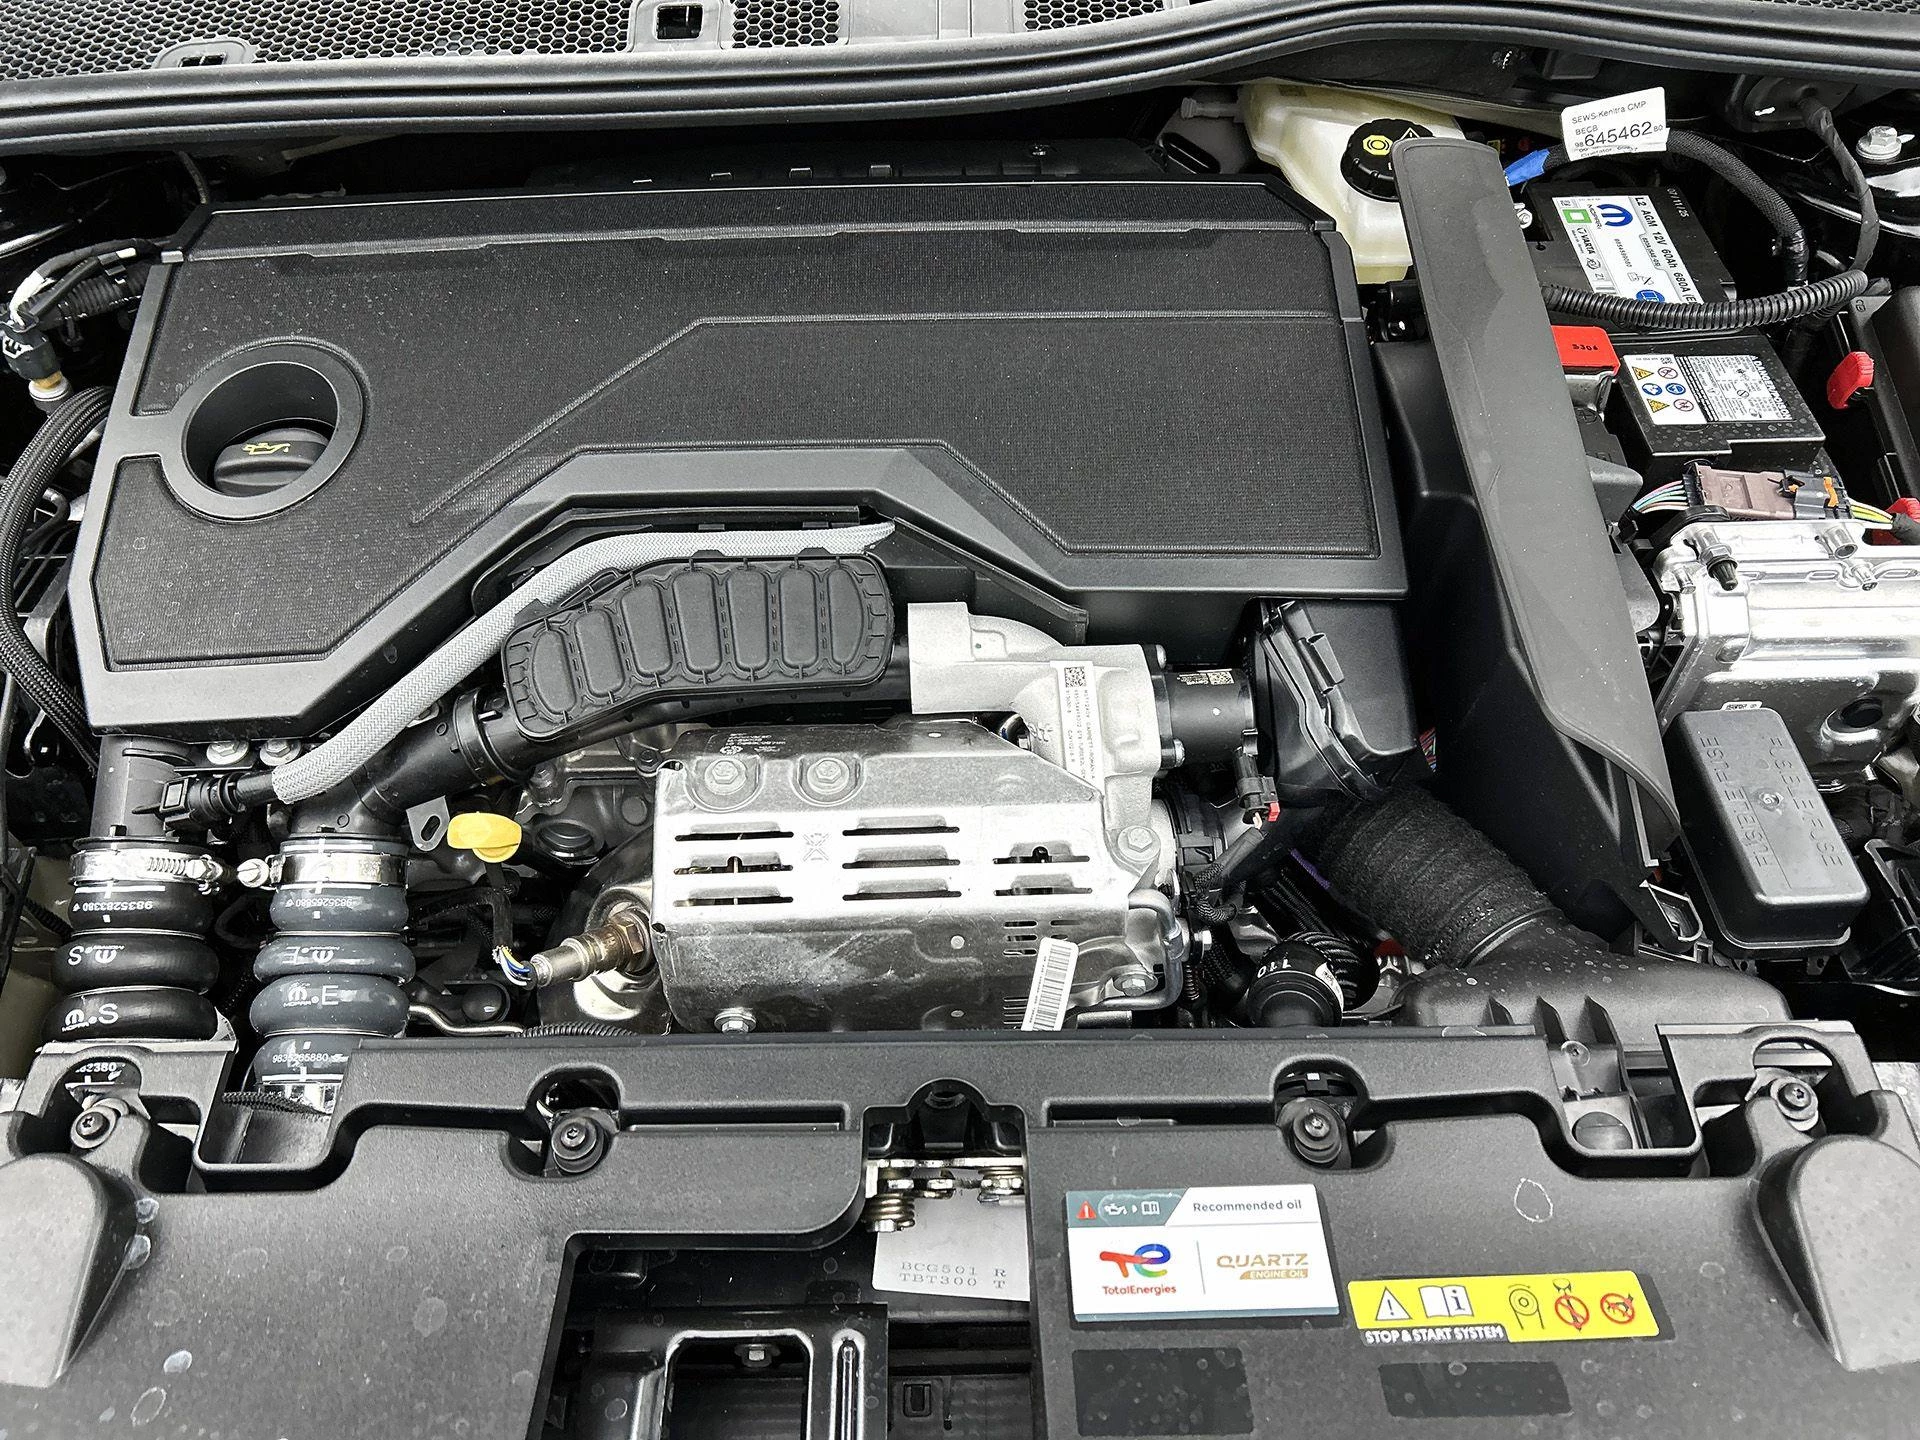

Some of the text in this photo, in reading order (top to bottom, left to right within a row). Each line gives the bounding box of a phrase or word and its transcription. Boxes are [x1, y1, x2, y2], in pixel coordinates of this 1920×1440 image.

[1627, 100, 1647, 111] CMP
[1582, 234, 1596, 255] VARTA
[1641, 210, 1657, 228] AGM
[1652, 231, 1668, 246] 12V
[1662, 248, 1677, 269] 60Ah
[1193, 1200, 1302, 1213] Recommended oil
[1216, 1253, 1309, 1268] QUARTZ
[994, 1268, 1007, 1277] R
[1249, 1268, 1306, 1279] ENGINE OIL
[1102, 1285, 1177, 1297] TotalEnergies
[1365, 1329, 1399, 1344] STOP
[1413, 1327, 1452, 1342] START
[1453, 1325, 1505, 1341] SYSTEM
